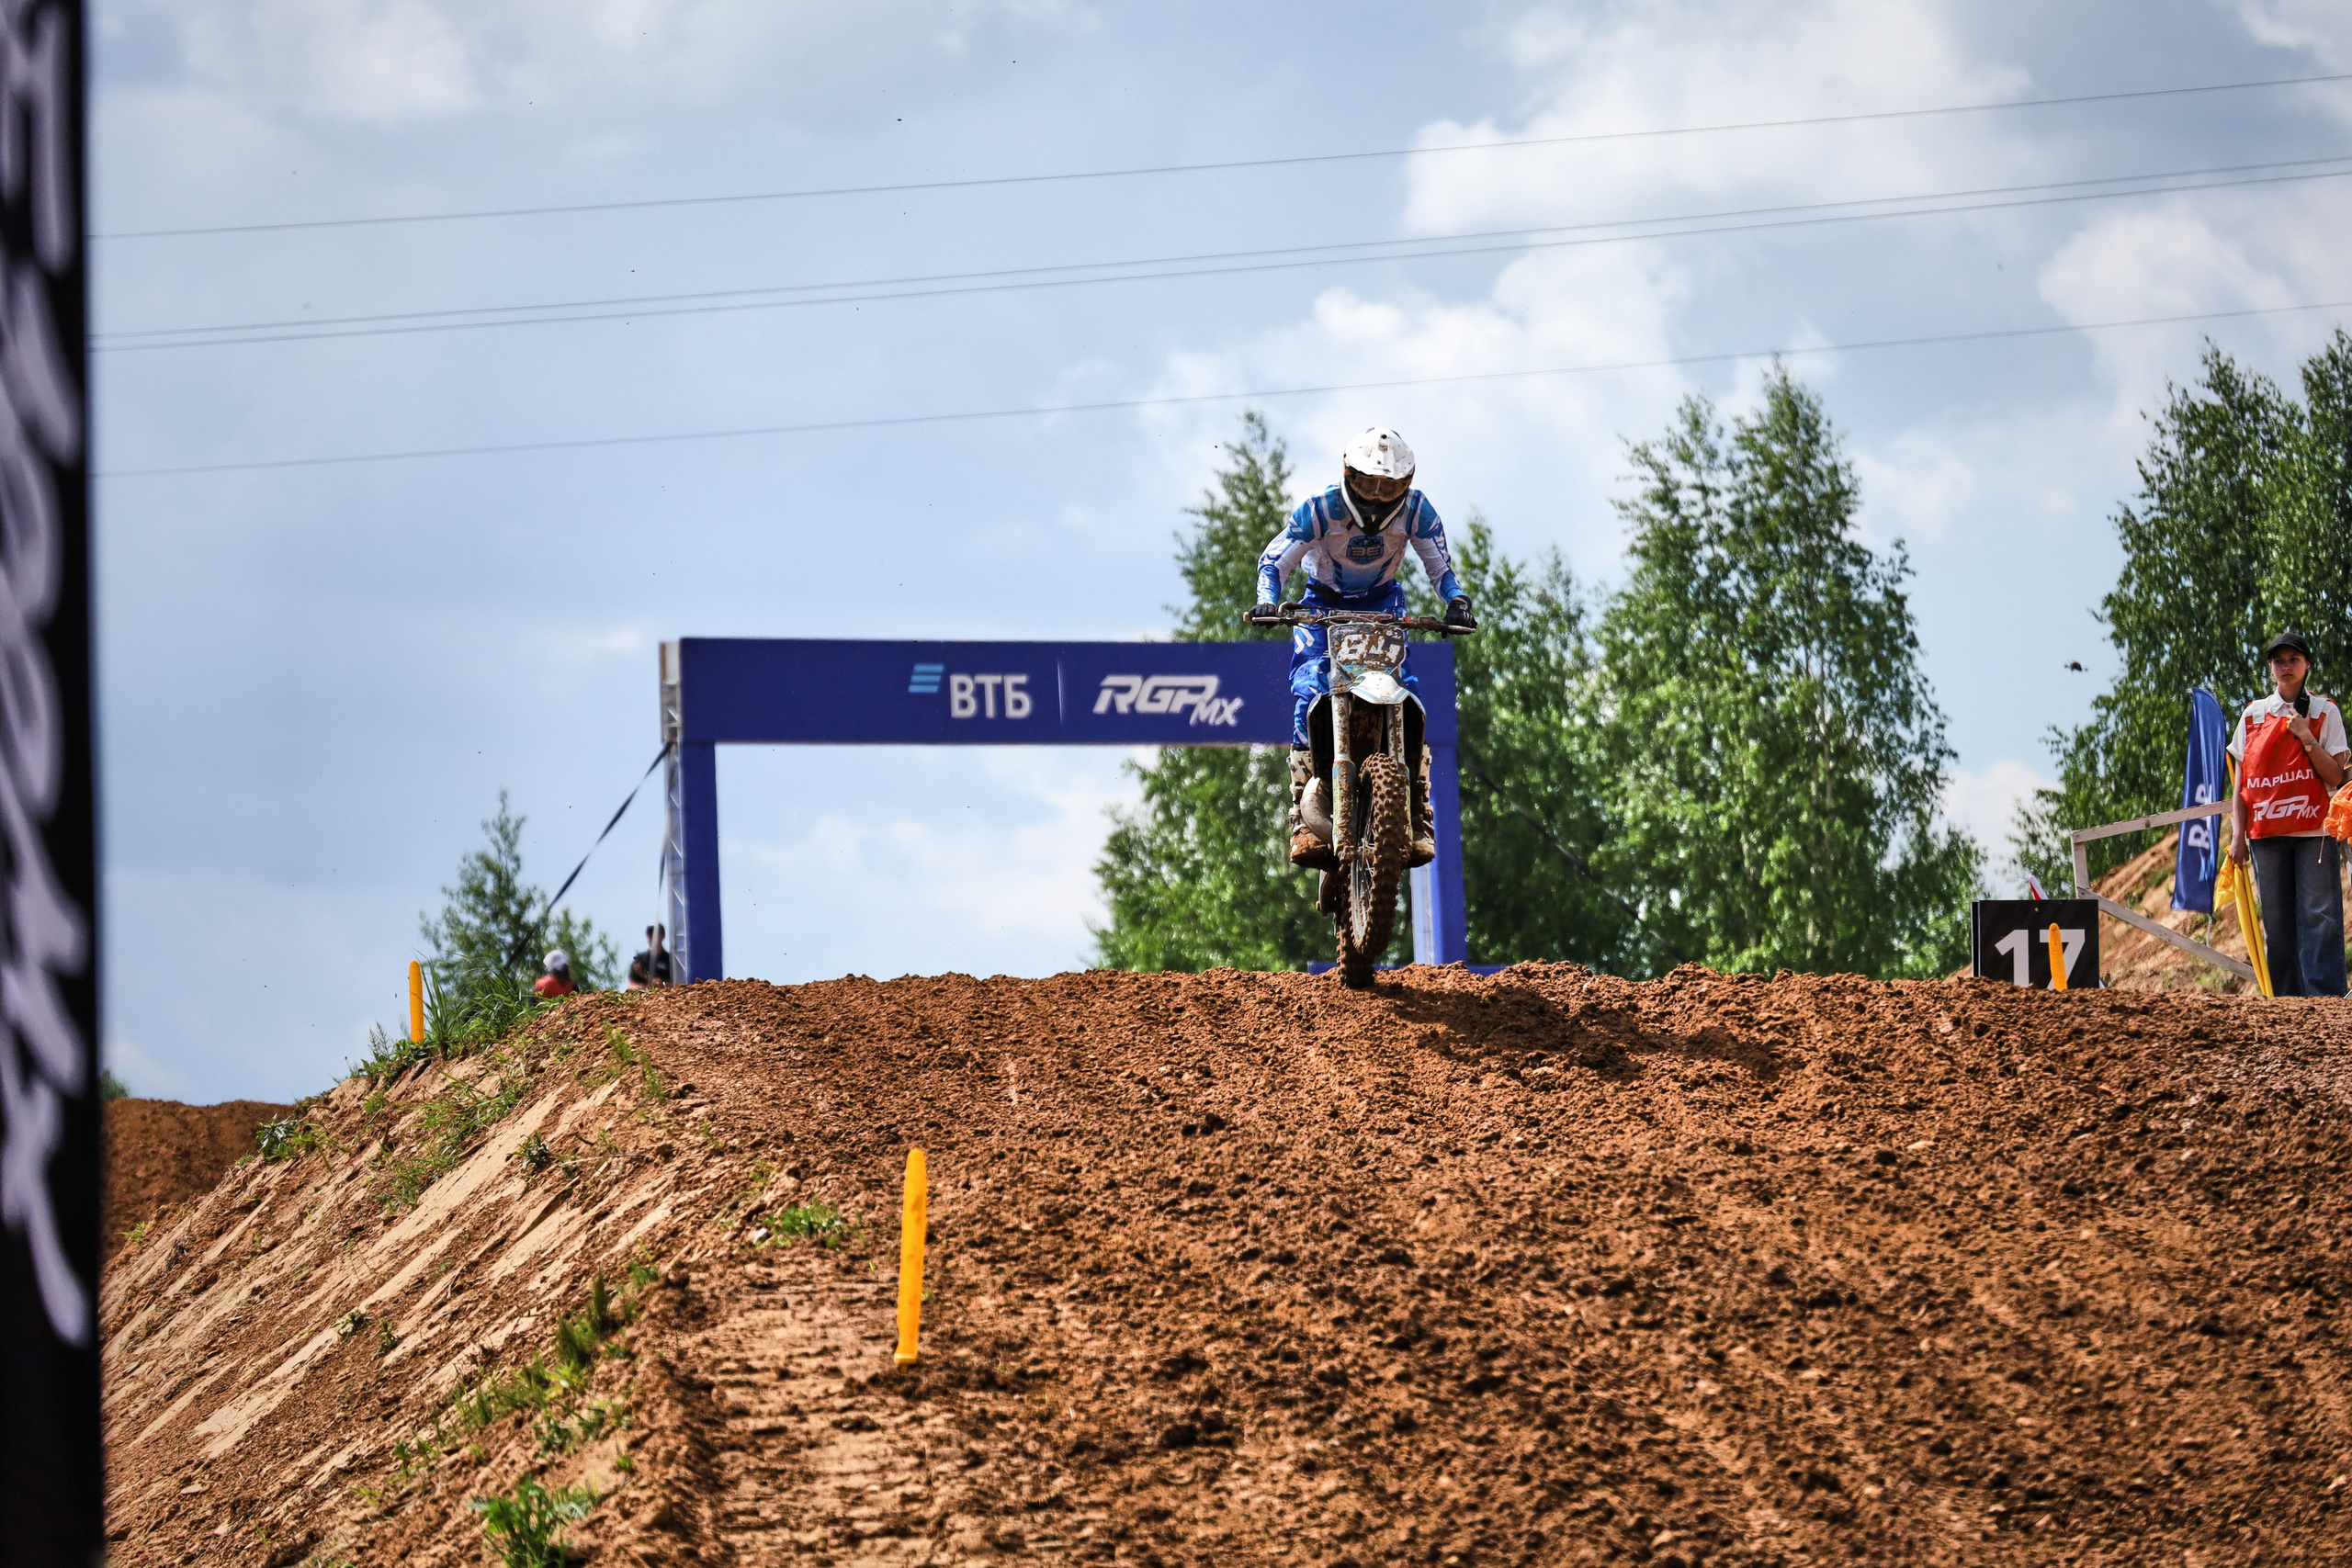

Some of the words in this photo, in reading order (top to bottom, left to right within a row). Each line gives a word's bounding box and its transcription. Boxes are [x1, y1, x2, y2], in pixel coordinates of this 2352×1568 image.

[949, 674, 1032, 718] ВТБ
[2246, 769, 2313, 788] МАРШАЛ
[1995, 929, 2086, 990] 17
